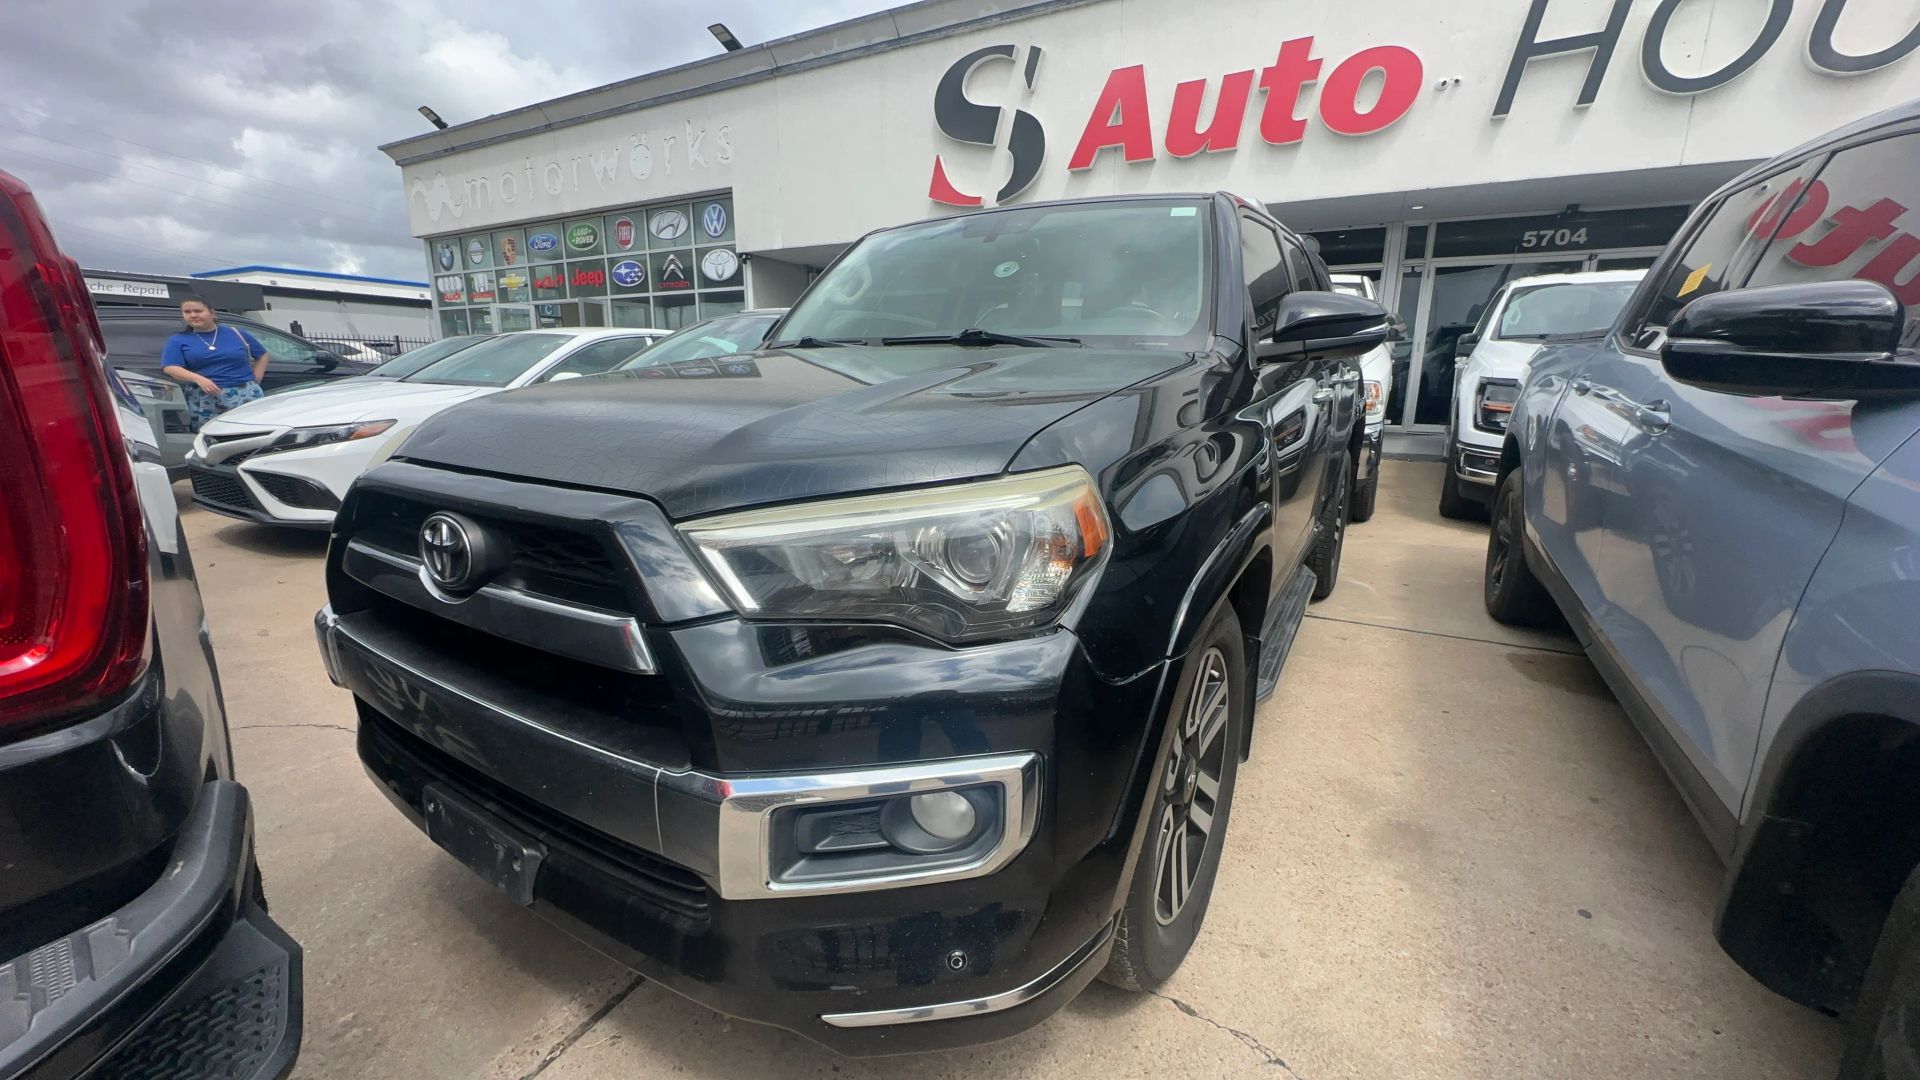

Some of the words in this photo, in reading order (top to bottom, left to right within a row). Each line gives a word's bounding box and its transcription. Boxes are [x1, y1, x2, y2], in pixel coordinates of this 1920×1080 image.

[1069, 37, 1423, 171] Auto
[573, 228, 588, 236] LAND
[1522, 227, 1587, 249] 5704
[533, 239, 553, 249] Ford
[575, 236, 594, 244] ROVER
[571, 268, 604, 287] Jeep
[86, 282, 113, 292] che
[123, 283, 167, 296] Repair
